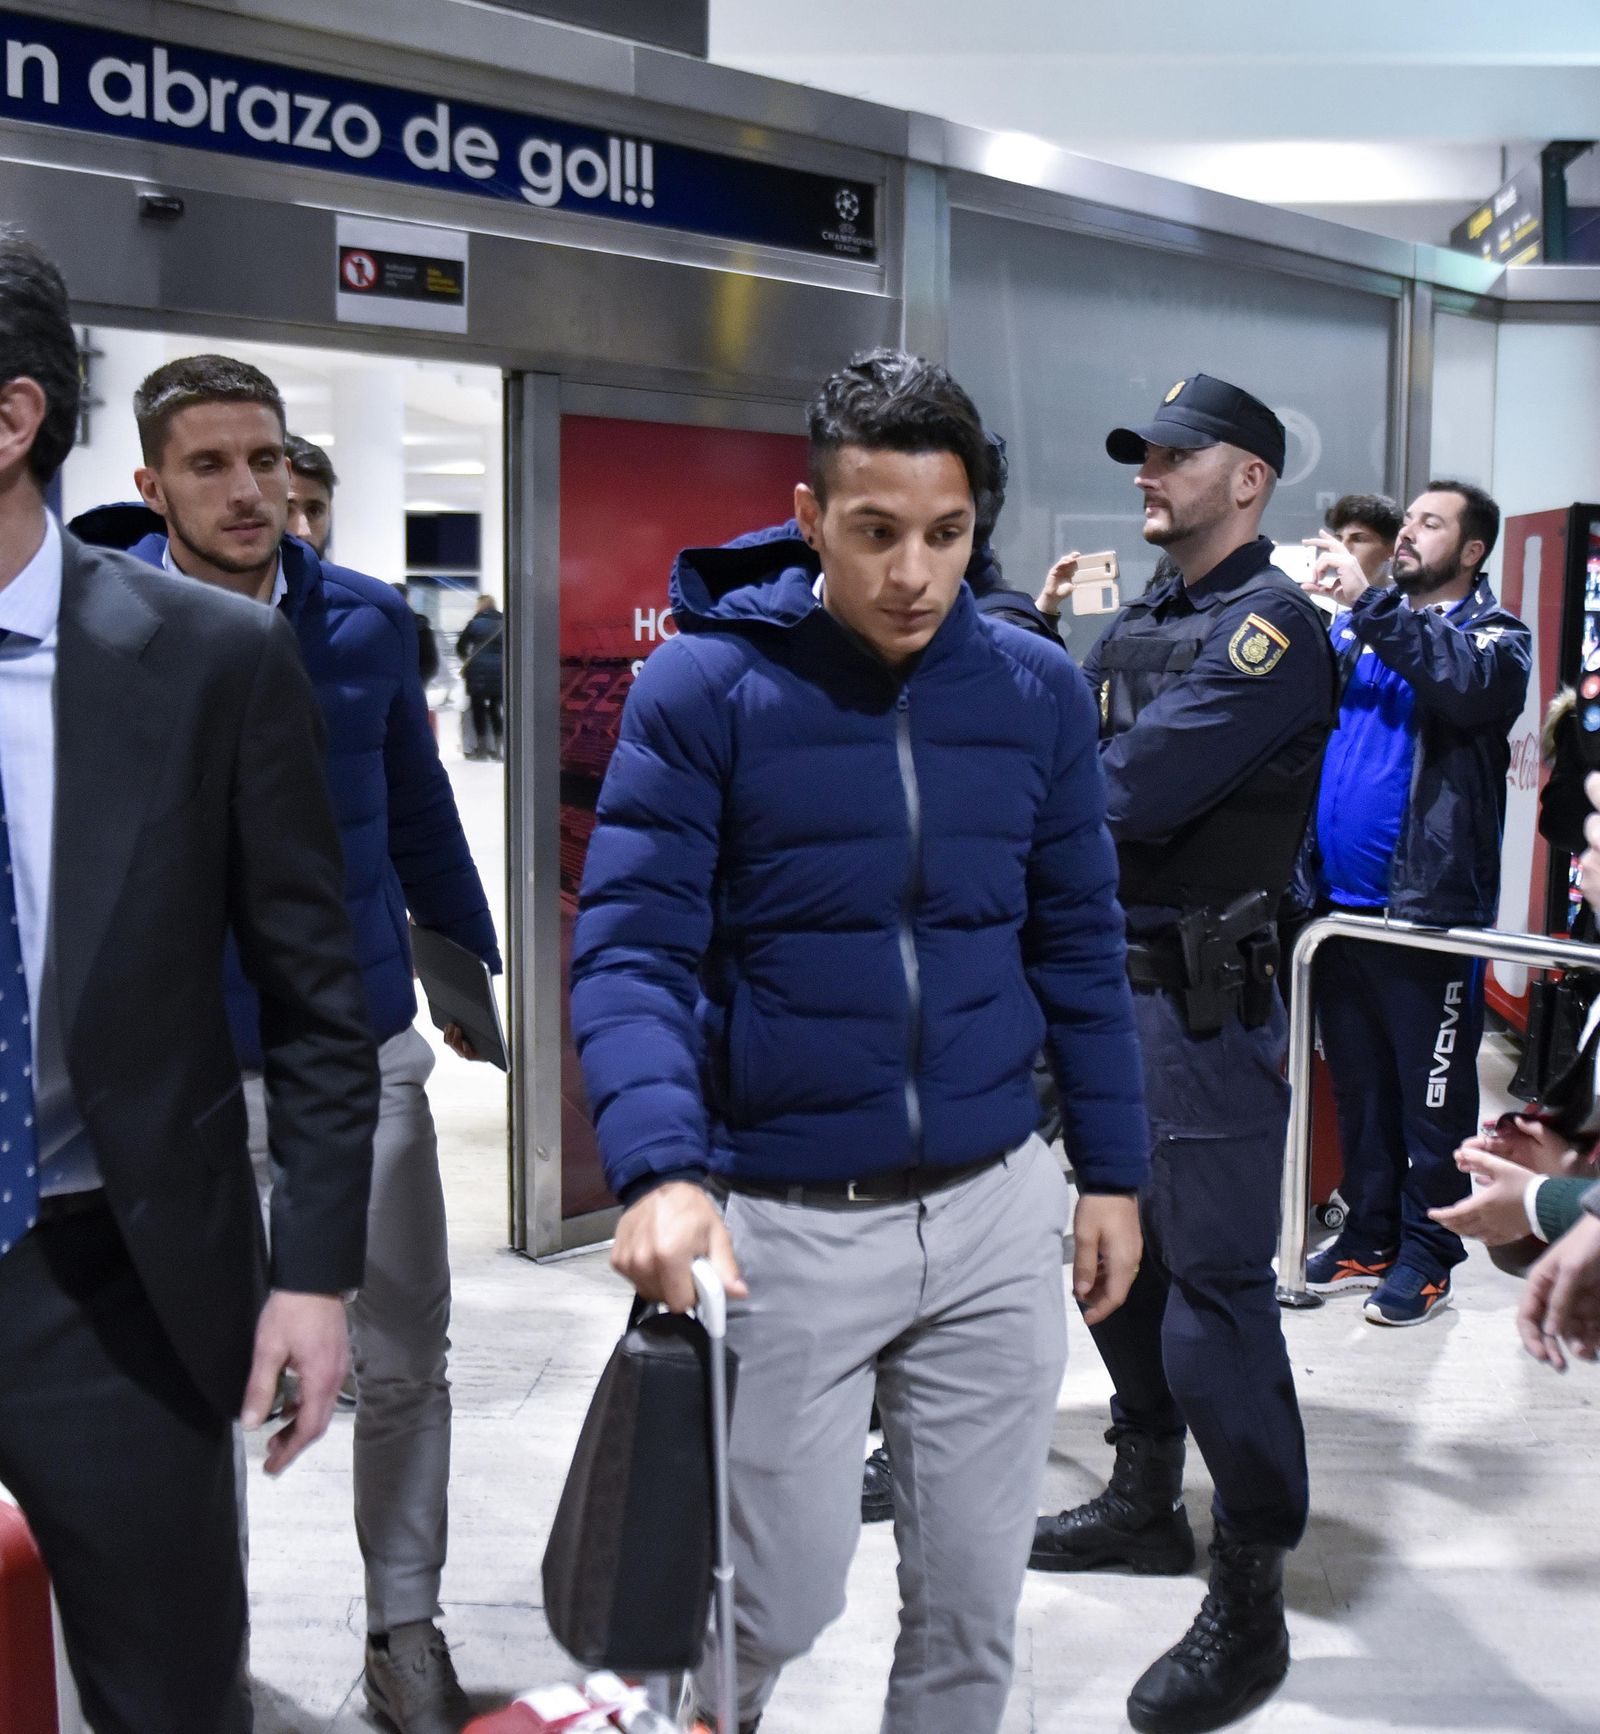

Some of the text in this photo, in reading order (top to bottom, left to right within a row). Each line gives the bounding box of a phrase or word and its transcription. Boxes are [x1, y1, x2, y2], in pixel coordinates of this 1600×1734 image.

[7, 40, 655, 208] n abrazo de gol!!
[1425, 980, 1464, 1108] GIVOVA
